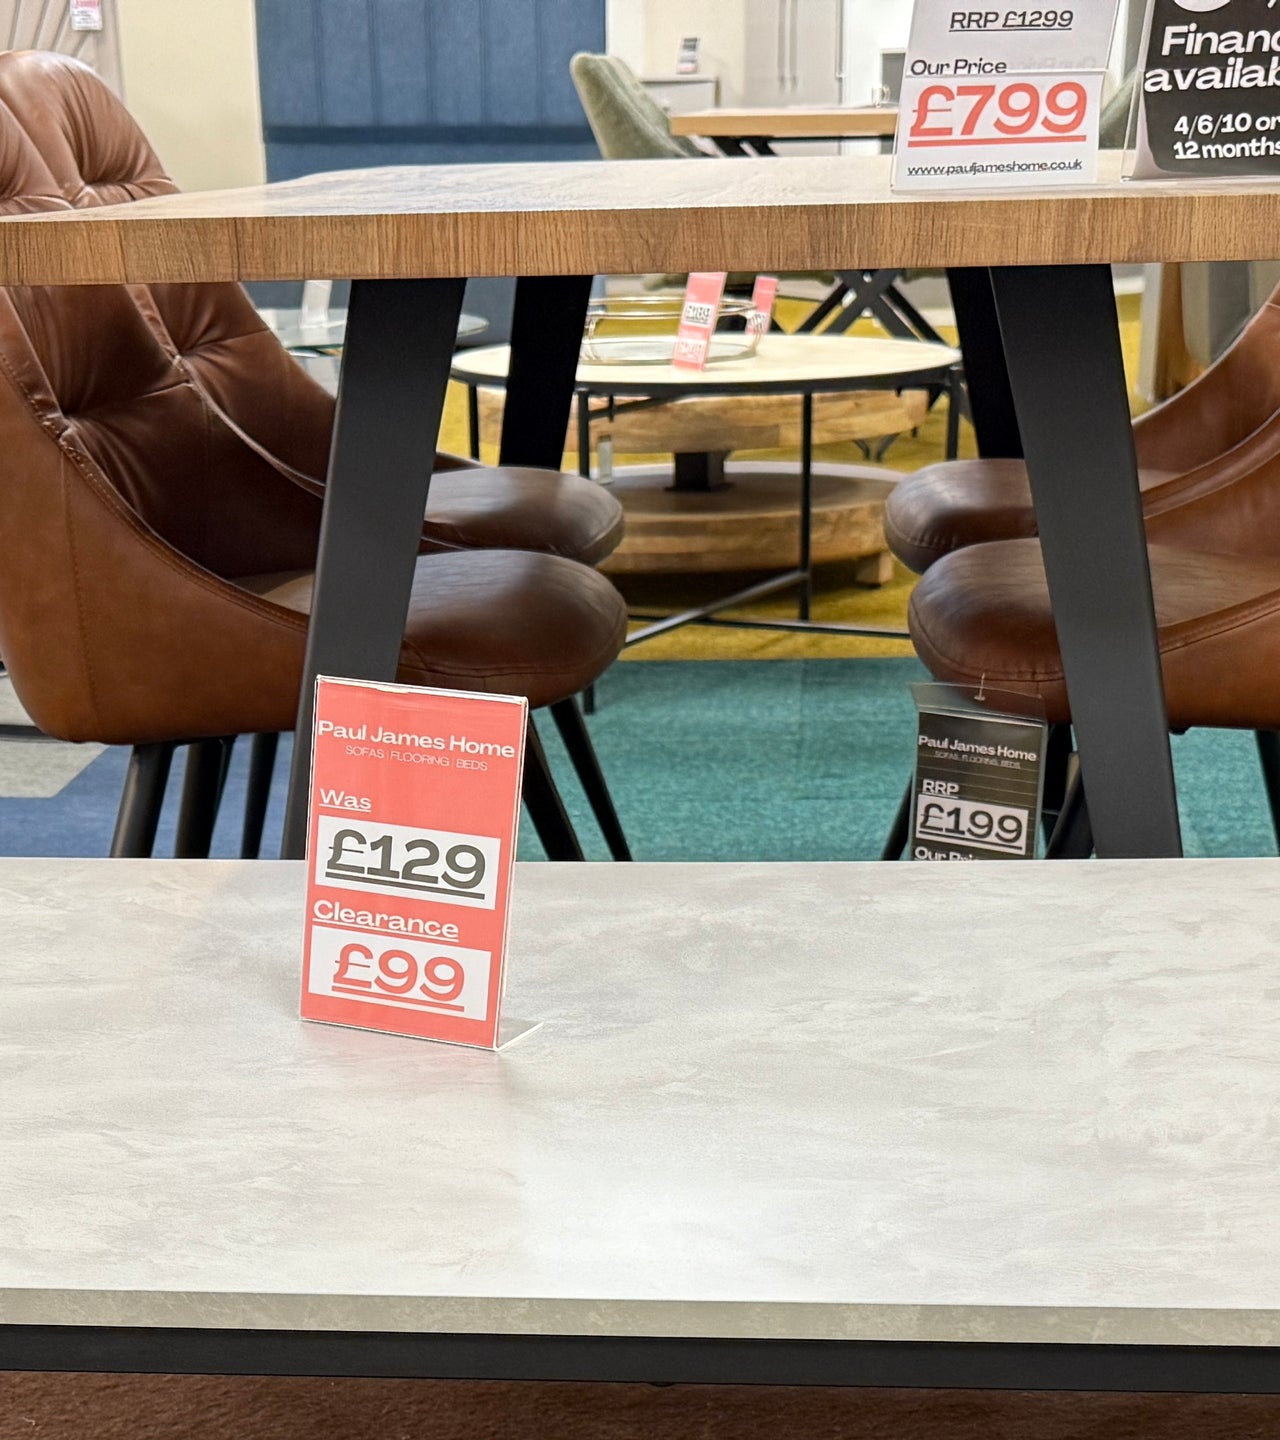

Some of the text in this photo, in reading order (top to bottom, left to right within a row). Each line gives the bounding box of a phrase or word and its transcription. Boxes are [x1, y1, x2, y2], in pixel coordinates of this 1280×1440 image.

[950, 10, 1074, 29] RRP £1299
[910, 59, 950, 76] Our
[953, 57, 1007, 75] Price
[909, 81, 1087, 137] £799
[1174, 113, 1252, 139] 4/6/10
[1173, 141, 1200, 159] 12
[908, 159, 1082, 176] www.pauljameshome.co.uk
[318, 720, 515, 758] Paul James Home
[918, 735, 1037, 761] Paul James Home
[345, 745, 488, 771] SOFAS FLOORING BEDS
[321, 788, 372, 811] Was
[922, 779, 959, 796] RRP
[920, 803, 1023, 844] £199
[326, 829, 486, 890] £129
[915, 846, 946, 860] Our
[313, 899, 459, 938] Clearance
[331, 943, 465, 1001] £99
